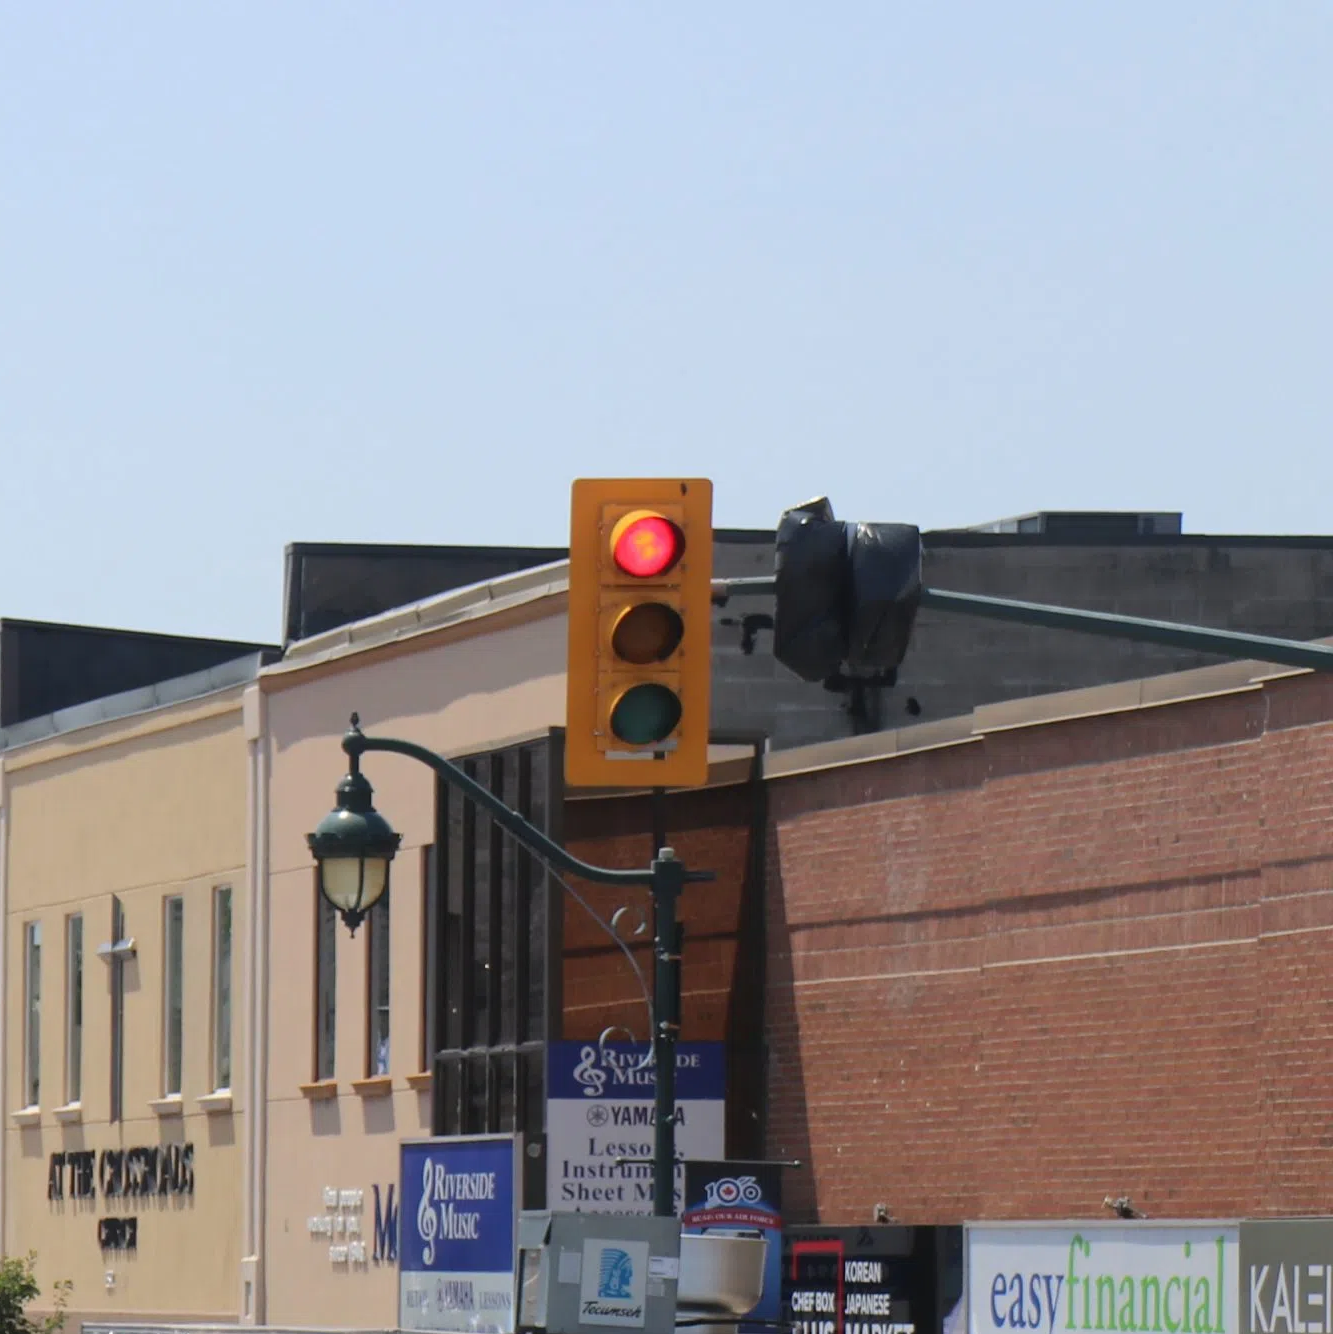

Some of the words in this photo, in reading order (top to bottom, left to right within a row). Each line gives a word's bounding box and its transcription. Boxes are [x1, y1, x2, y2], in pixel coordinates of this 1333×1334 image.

[561, 1182, 625, 1202] Sheet
[844, 1260, 882, 1283] KOREAN
[791, 1291, 815, 1312] CHEF
[816, 1291, 835, 1313] BOX
[844, 1293, 891, 1316] JAPANESE
